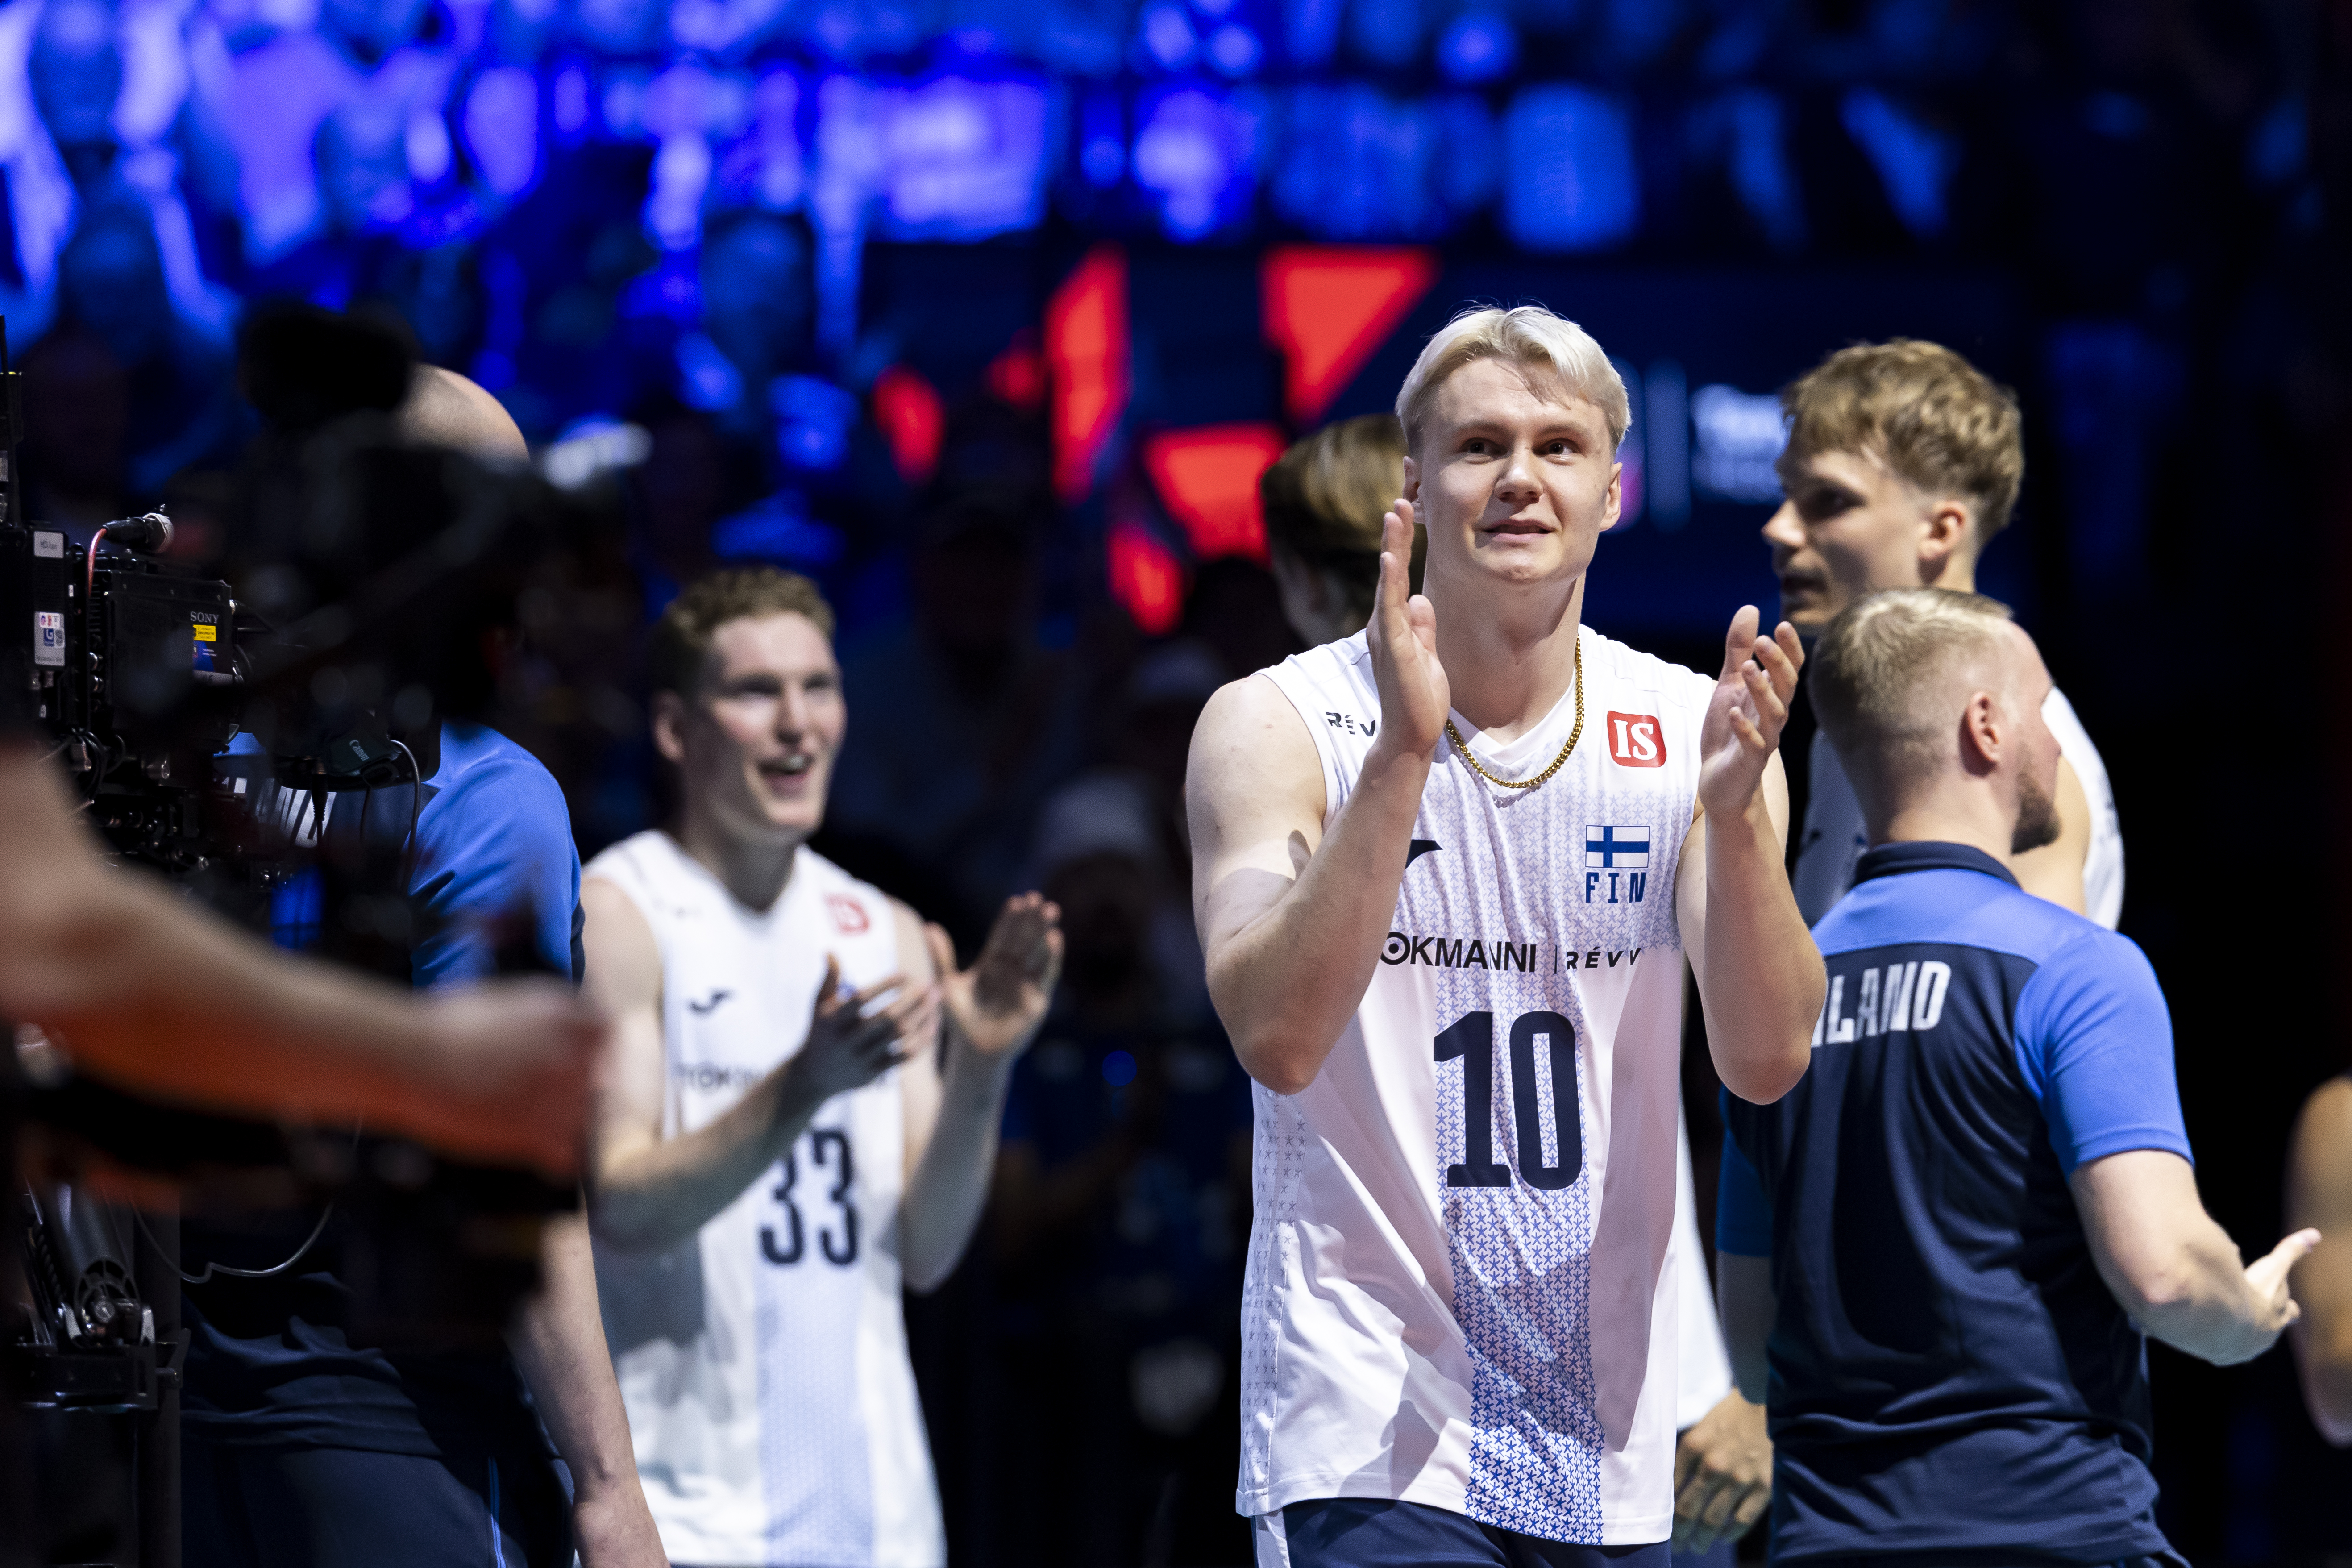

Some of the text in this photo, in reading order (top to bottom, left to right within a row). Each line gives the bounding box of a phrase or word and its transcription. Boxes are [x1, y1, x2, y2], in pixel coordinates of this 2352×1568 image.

[190, 611, 219, 624] SONY
[1326, 711, 1375, 737] RÉV
[1613, 719, 1658, 760] IS
[349, 740, 369, 761] Canon
[1586, 872, 1647, 903] FIN
[1380, 932, 1537, 973] OKMANNI
[1811, 961, 1952, 1047] LAND
[1433, 1010, 1583, 1191] 10
[760, 1129, 858, 1266] 33
